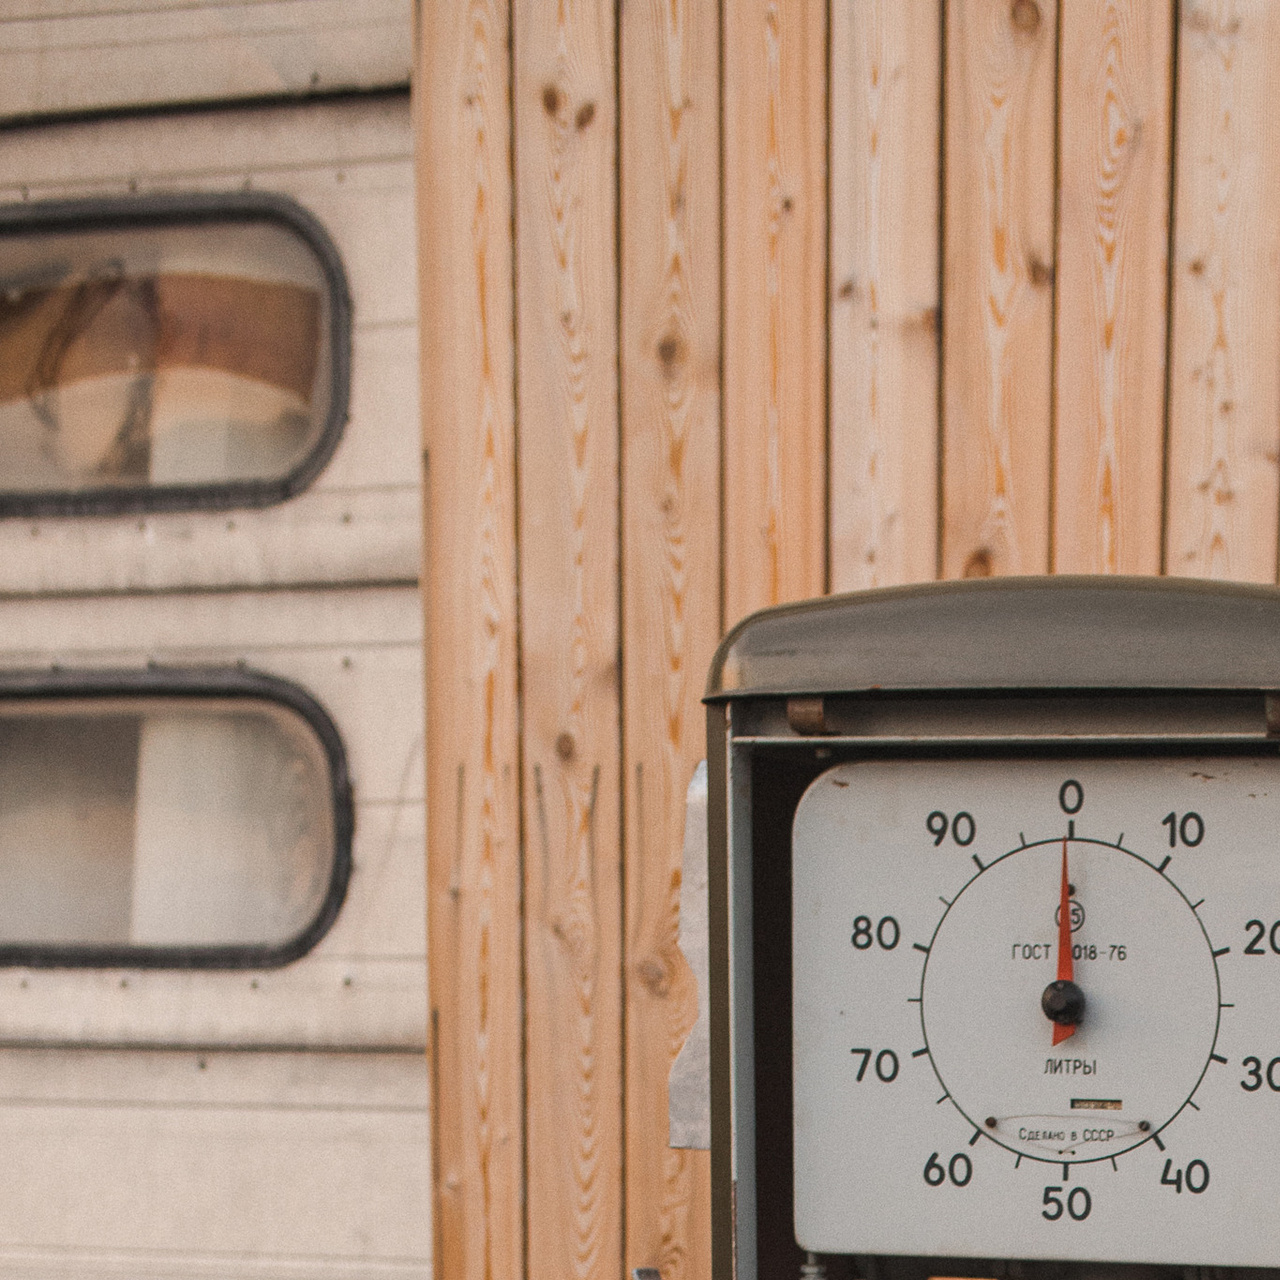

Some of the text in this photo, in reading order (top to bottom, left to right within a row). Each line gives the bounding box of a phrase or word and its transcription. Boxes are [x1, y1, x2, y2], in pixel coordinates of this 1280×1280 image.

[1058, 779, 1085, 815] 0
[926, 810, 976, 846] 90
[1162, 811, 1205, 848] 10
[850, 915, 901, 950] 80
[1011, 943, 1128, 961] ГОСТ 018-76
[850, 1048, 900, 1083] 70
[1043, 1058, 1098, 1076] ЛИТРЫ
[1082, 1128, 1115, 1142] СССР
[922, 1153, 973, 1187] 60
[1160, 1158, 1211, 1195] 40
[1041, 1186, 1093, 1222] 50
